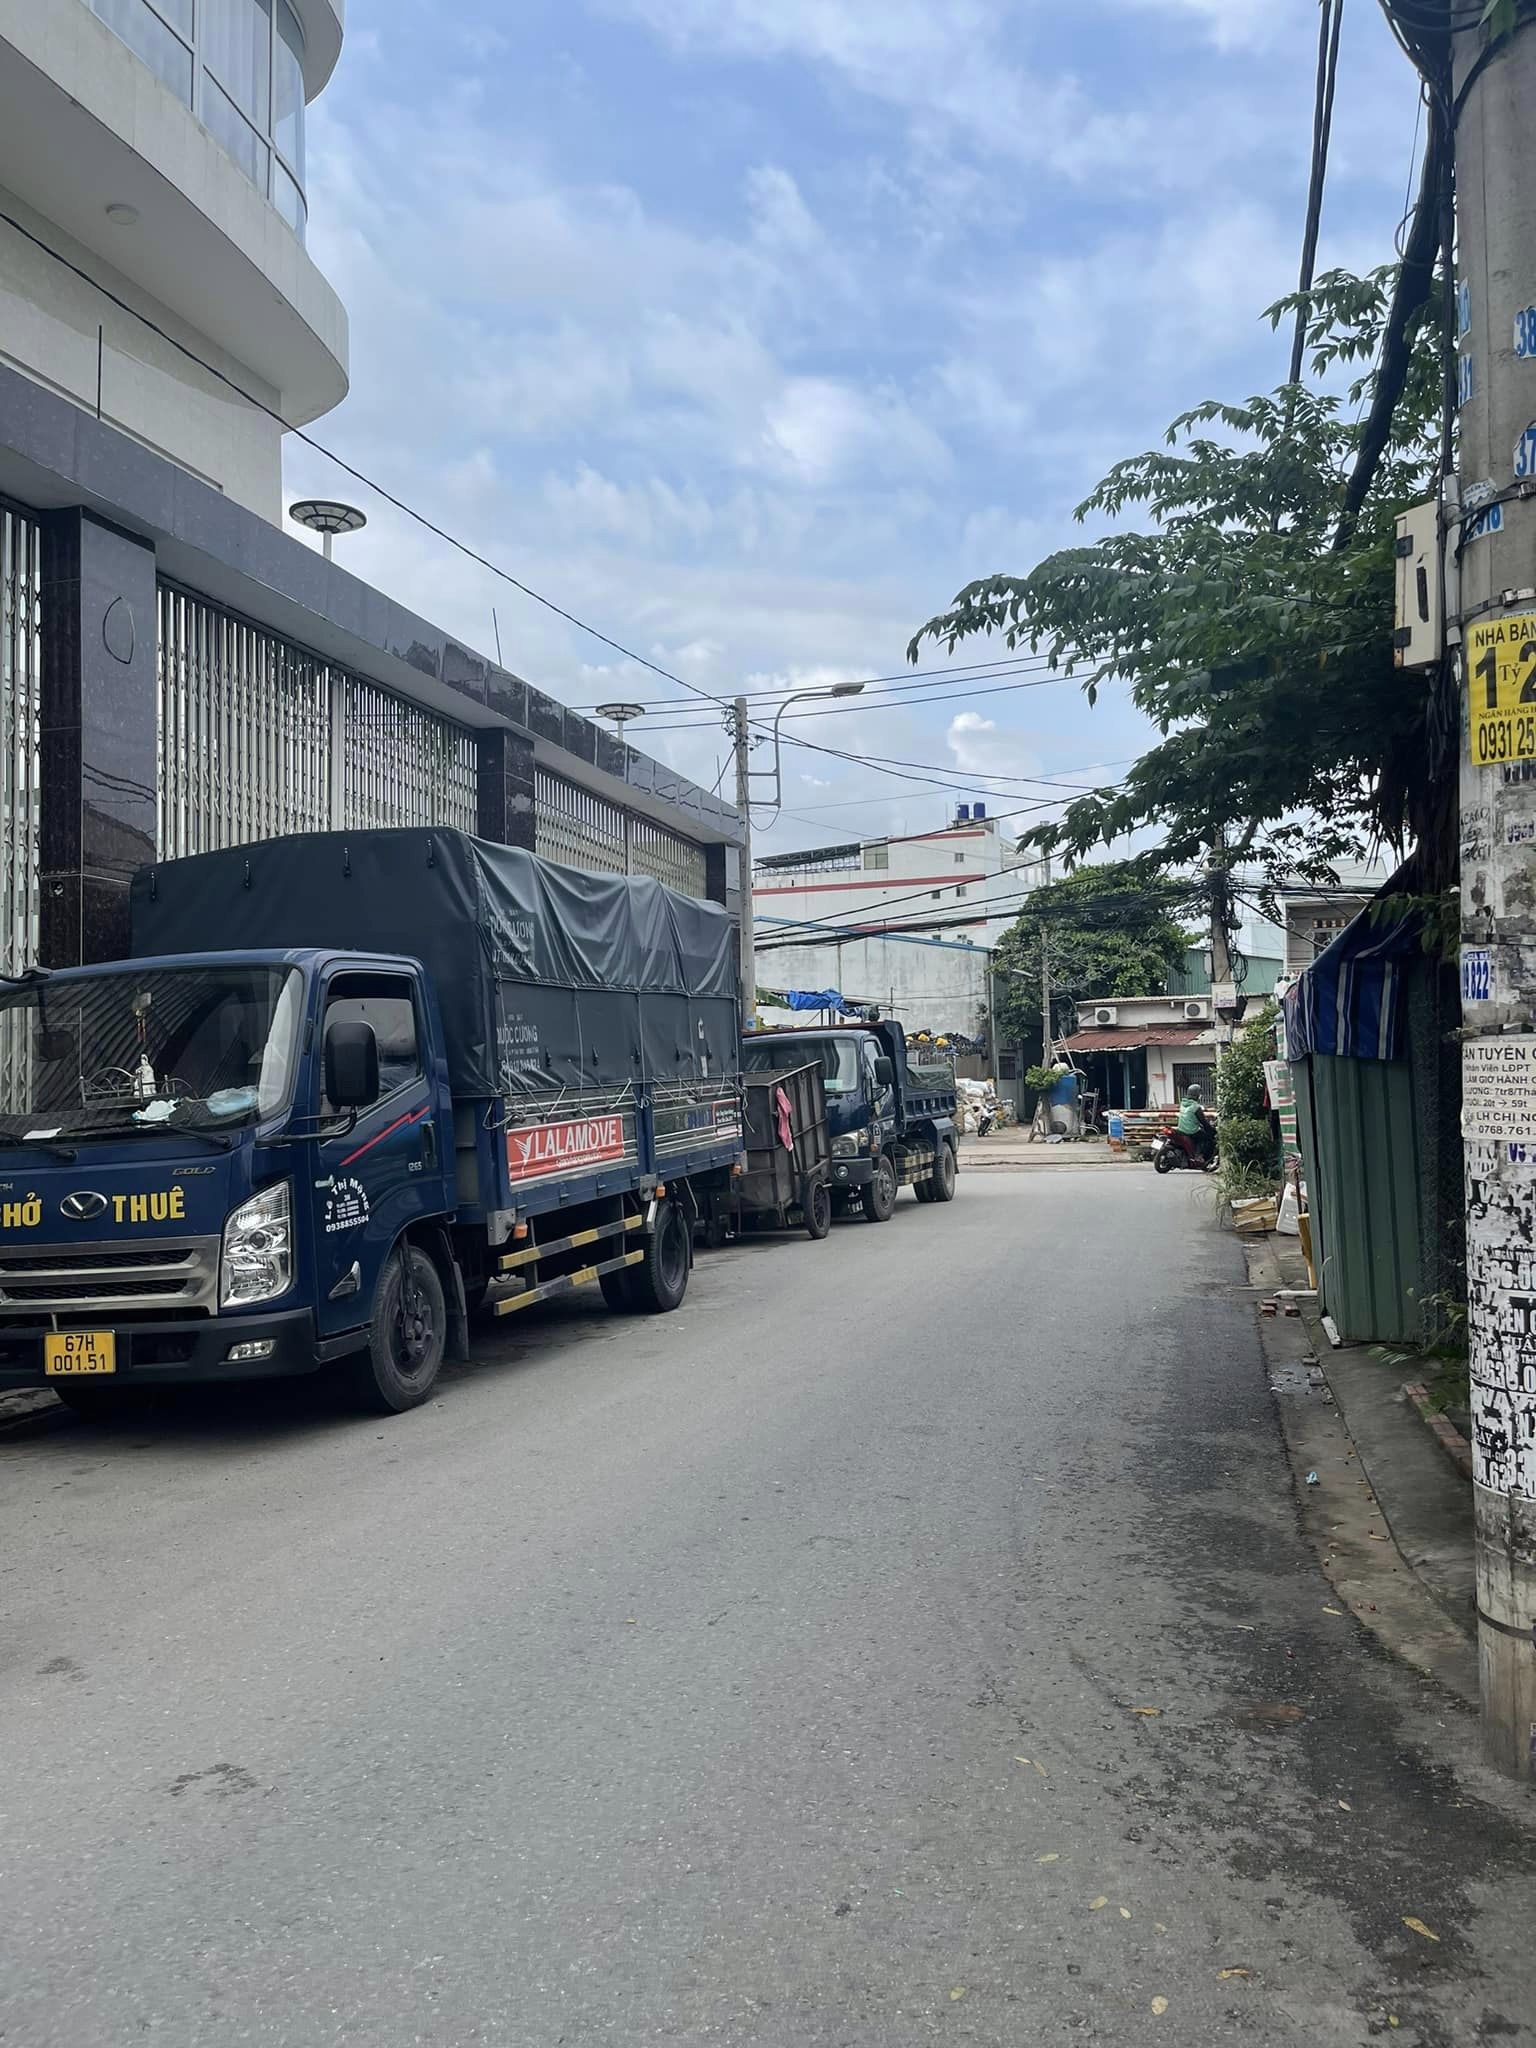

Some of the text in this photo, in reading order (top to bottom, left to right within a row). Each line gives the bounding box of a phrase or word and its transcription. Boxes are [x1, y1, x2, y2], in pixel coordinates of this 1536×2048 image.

[1479, 719, 1512, 761] 0931
[1511, 1100, 1528, 1108] 59t
[1476, 1112, 1490, 1121] LH
[535, 1120, 617, 1160] LALAMOVE
[0, 1186, 186, 1228] HỞ THUÊ
[65, 1335, 95, 1352] 67H
[54, 1354, 107, 1372] 001.51
